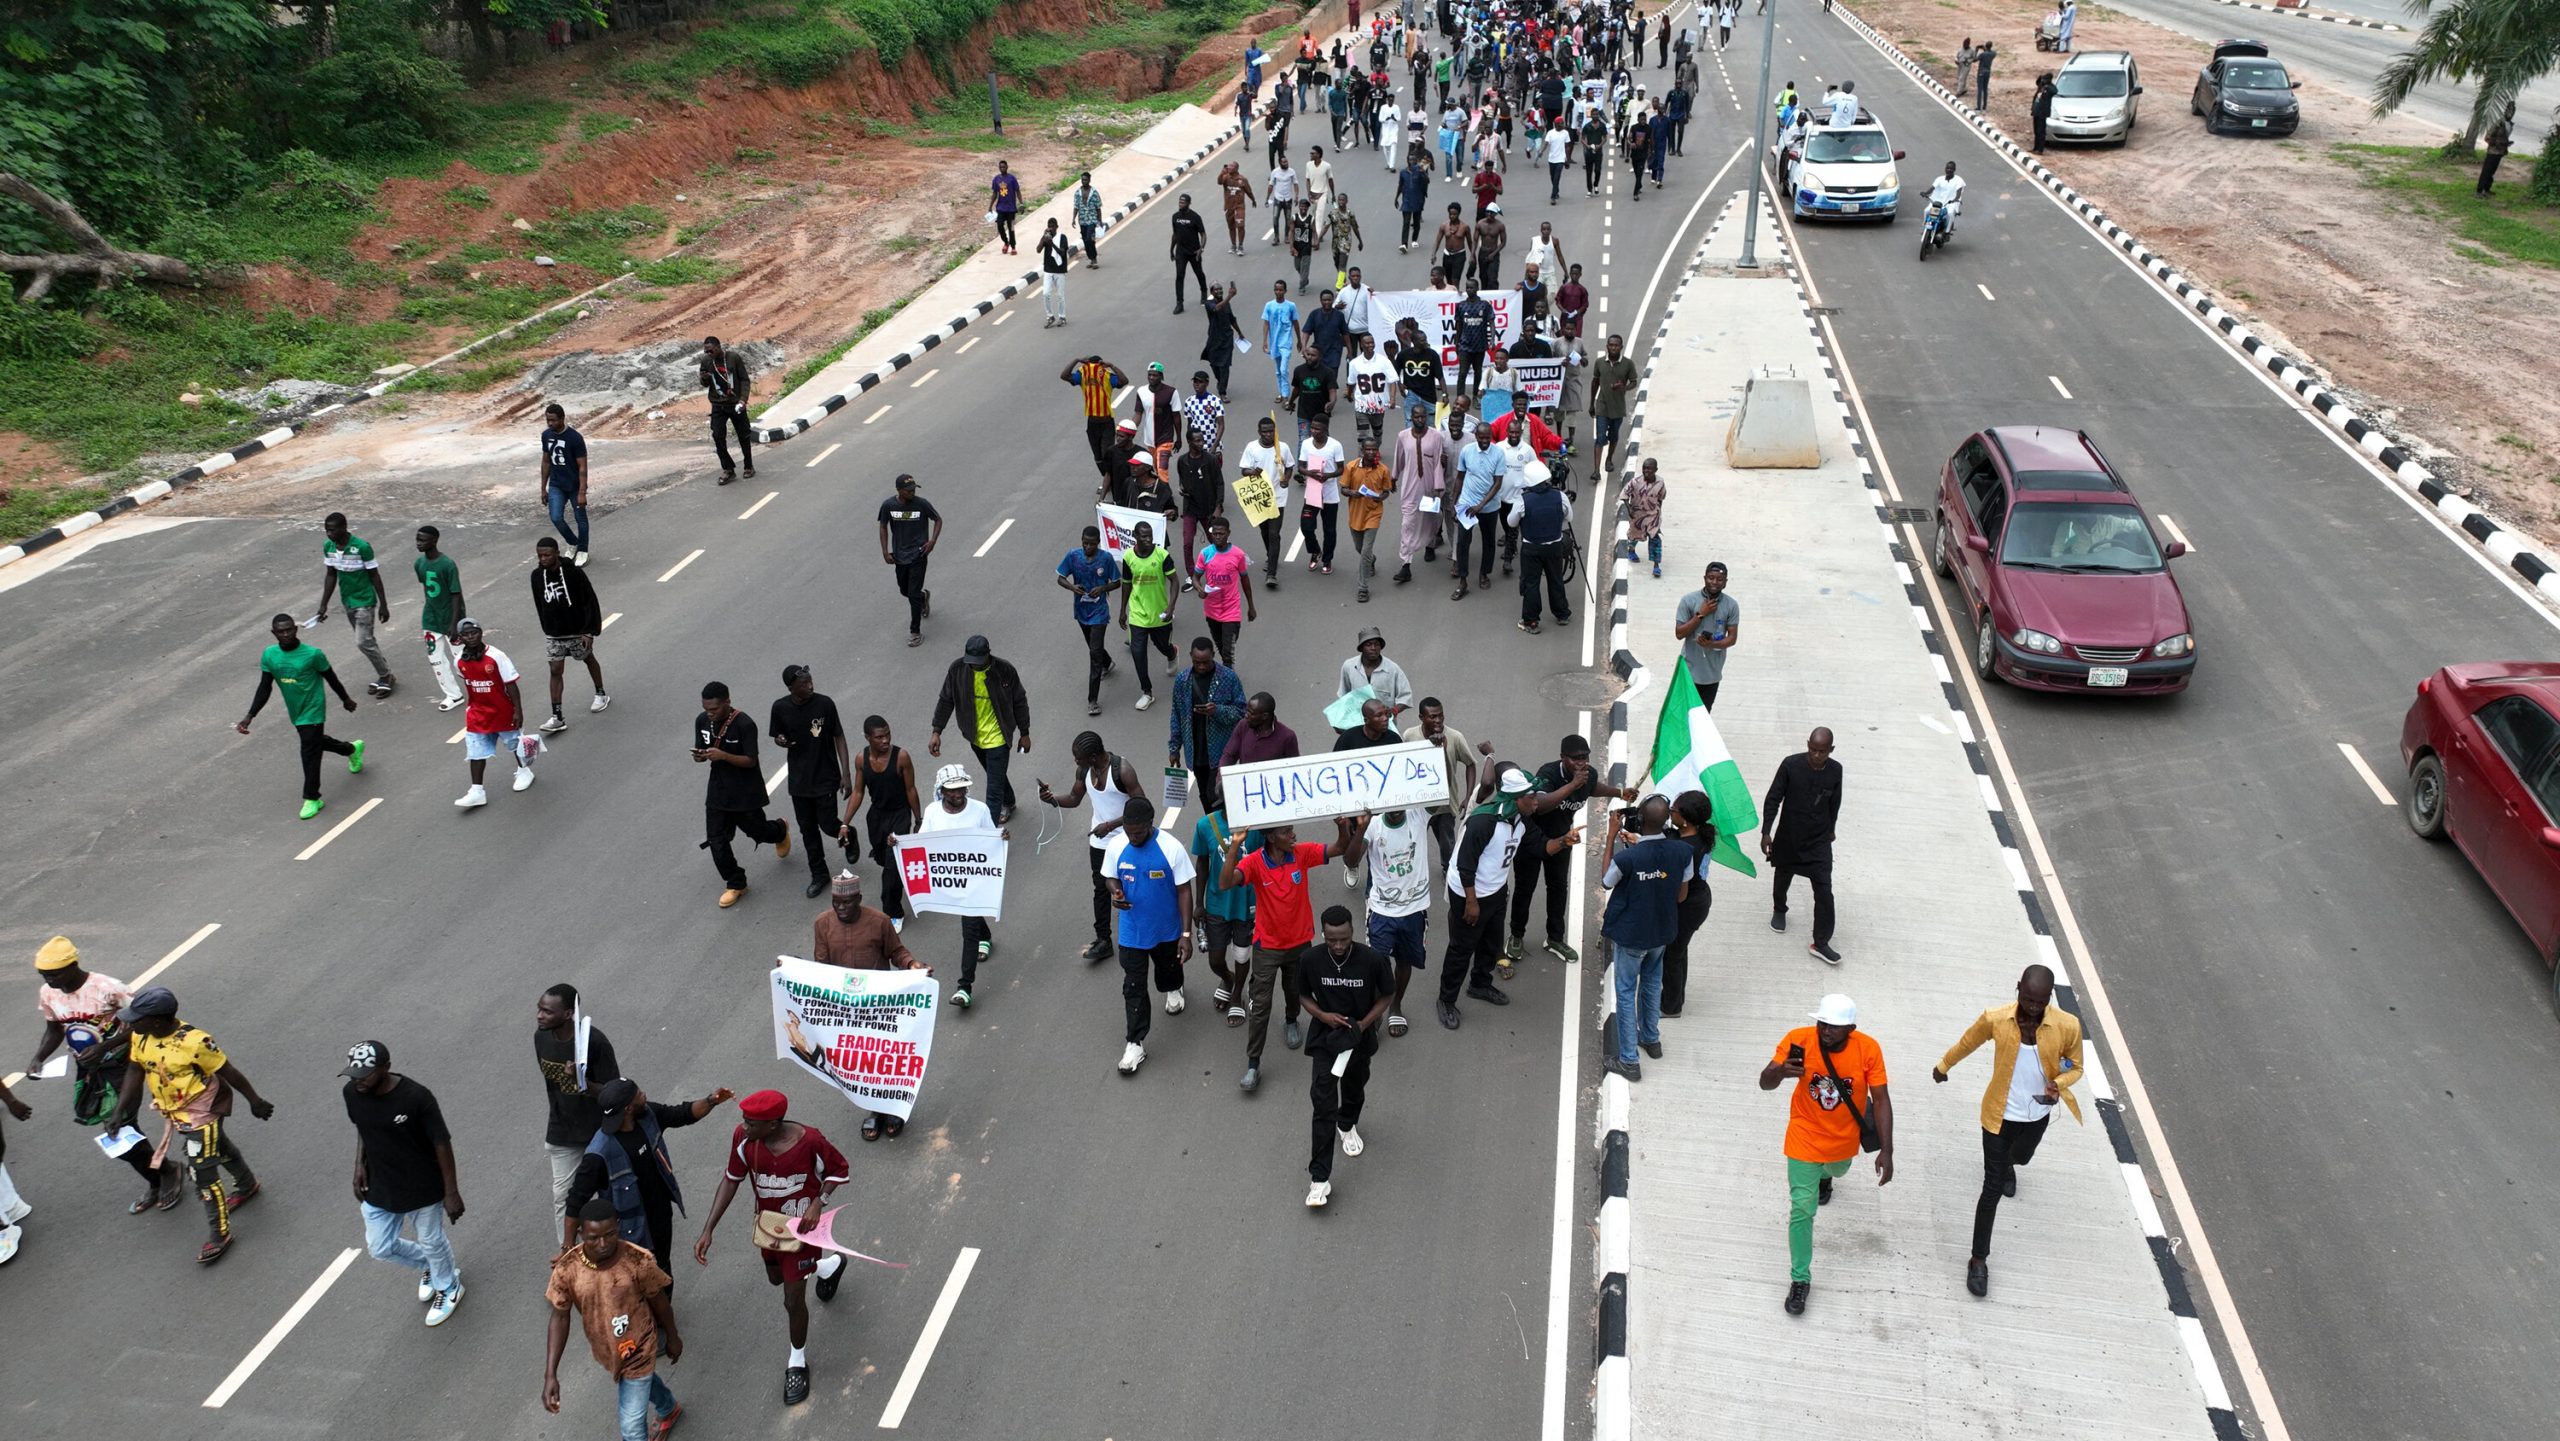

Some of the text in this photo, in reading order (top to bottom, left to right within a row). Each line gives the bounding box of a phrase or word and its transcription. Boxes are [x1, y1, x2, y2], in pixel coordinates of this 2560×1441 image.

[1521, 367, 1559, 379] NUBU
[425, 570, 441, 598] 5
[1242, 755, 1396, 813] HUNGRY
[928, 852, 988, 863] ENDBAD
[930, 865, 1003, 878] GOVERNANCE
[1395, 860, 1414, 877] 63
[931, 876, 968, 889] NOW
[1321, 976, 1364, 988] UNLIMITED
[802, 1007, 852, 1019] STRONGER
[880, 1013, 898, 1023] THE
[804, 998, 838, 1010] POWER
[840, 1005, 852, 1013] OF
[854, 1007, 870, 1015] THE
[872, 1006, 906, 1015] PEOPLE
[907, 1008, 917, 1018] IS
[801, 1013, 899, 1034] PEOPLE IN THE POWER
[836, 1033, 917, 1055] ERADICATE
[825, 1047, 925, 1080] HUNGER
[862, 1074, 882, 1085] OUR
[883, 1077, 917, 1089] NATION
[860, 1086, 870, 1097] IS
[780, 1196, 812, 1218] 40
